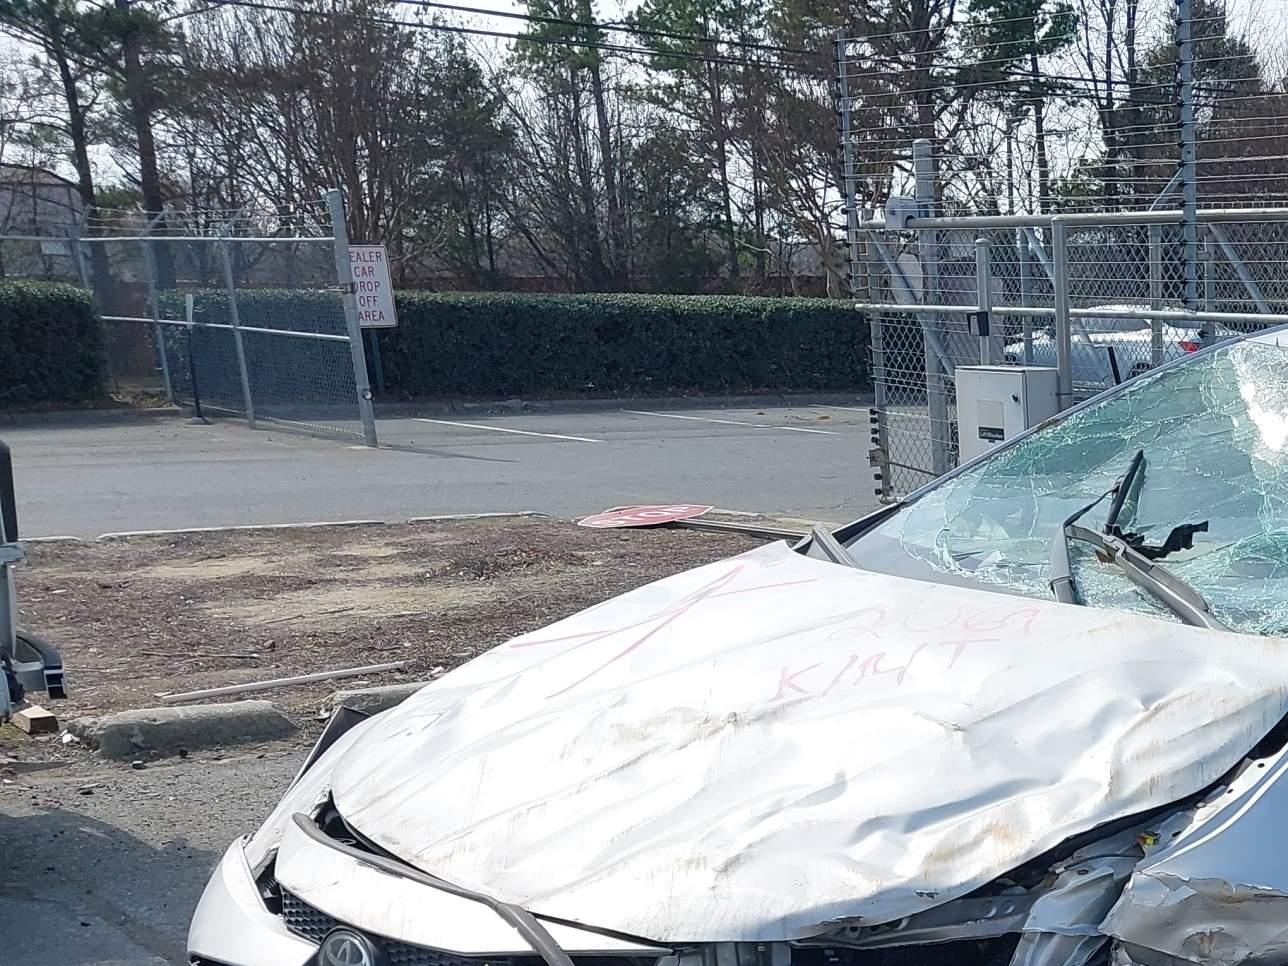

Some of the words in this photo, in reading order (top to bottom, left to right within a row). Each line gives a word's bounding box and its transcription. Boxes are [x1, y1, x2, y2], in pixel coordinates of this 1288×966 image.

[349, 251, 383, 263] EALER
[353, 266, 375, 278] CAR
[353, 281, 381, 294] DROP
[358, 295, 379, 308] OFF
[359, 311, 385, 321] AREA
